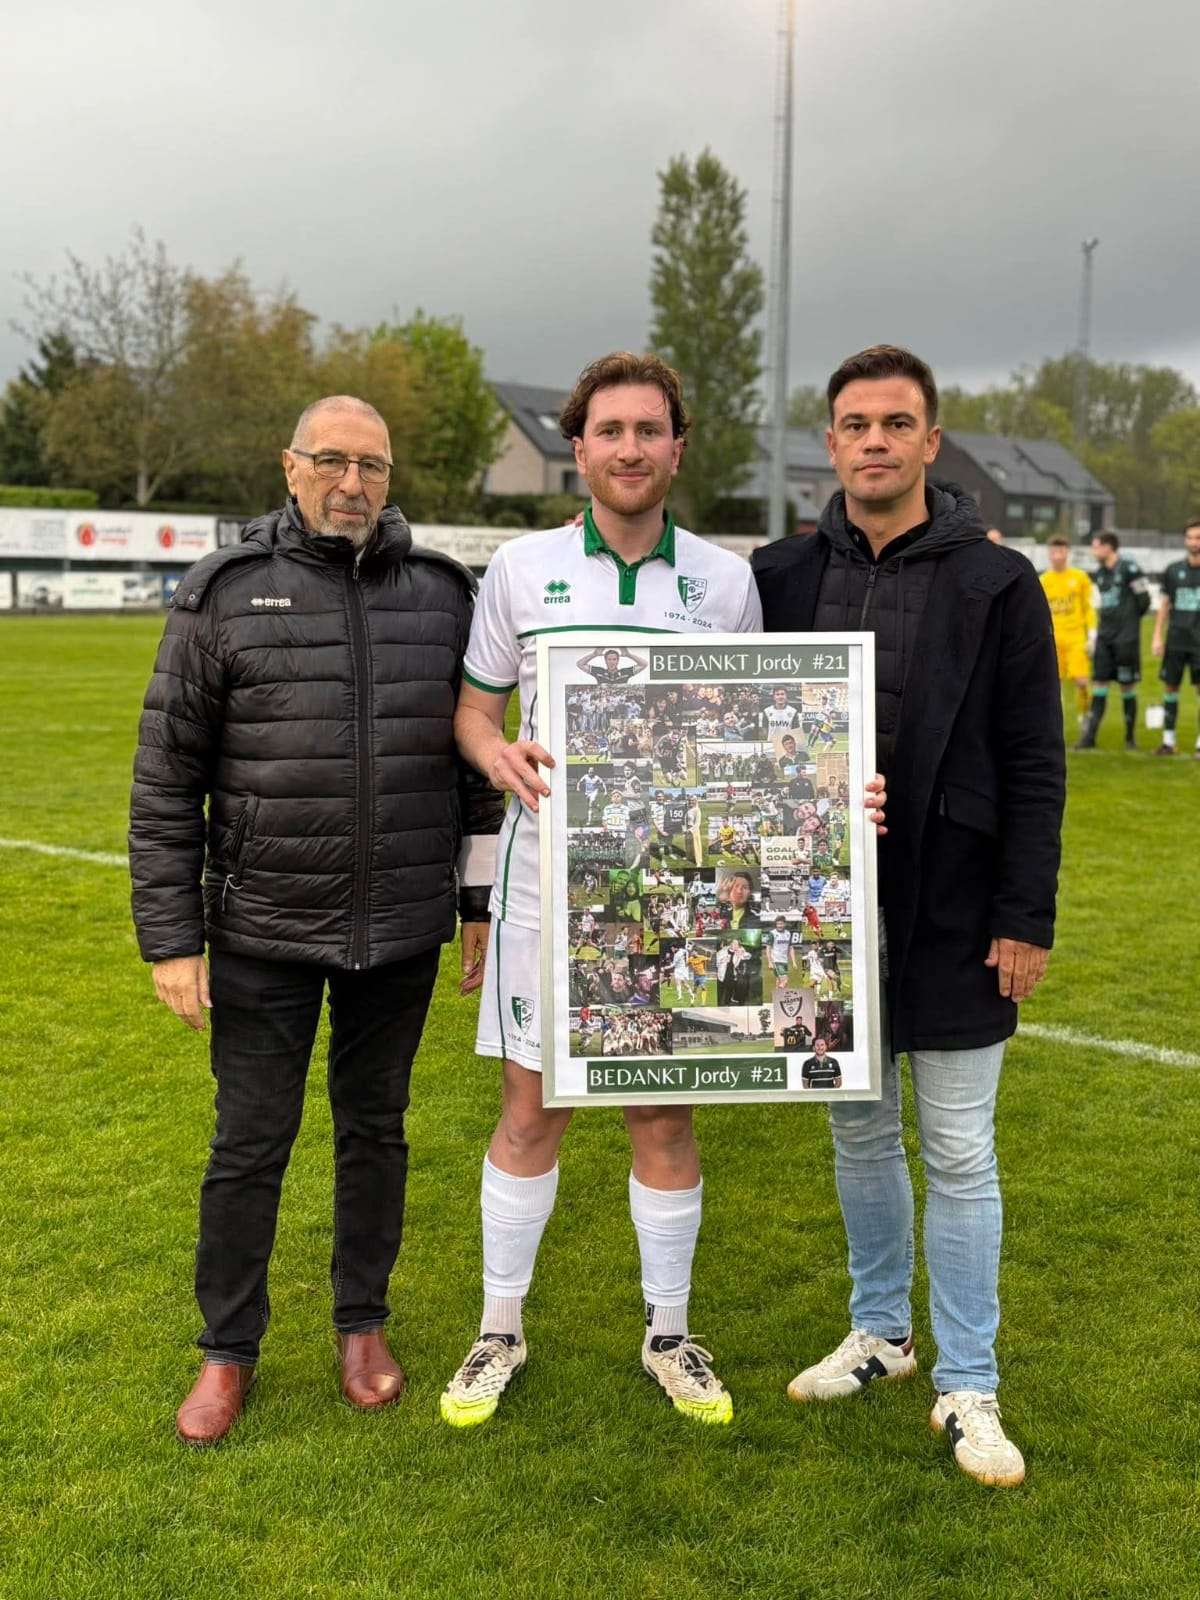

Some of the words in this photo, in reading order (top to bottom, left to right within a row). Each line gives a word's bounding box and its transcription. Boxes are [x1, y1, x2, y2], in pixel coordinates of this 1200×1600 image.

[264, 598, 291, 607] errea
[543, 596, 570, 604] errea
[664, 611, 686, 621] 1974
[692, 617, 712, 629] 2024
[652, 654, 749, 672] BEDANKT
[752, 653, 801, 675] Jordy
[812, 653, 846, 671] #21
[589, 1067, 687, 1086] BEDANKT
[691, 1066, 740, 1088] Jordy
[751, 1066, 784, 1083] #21
